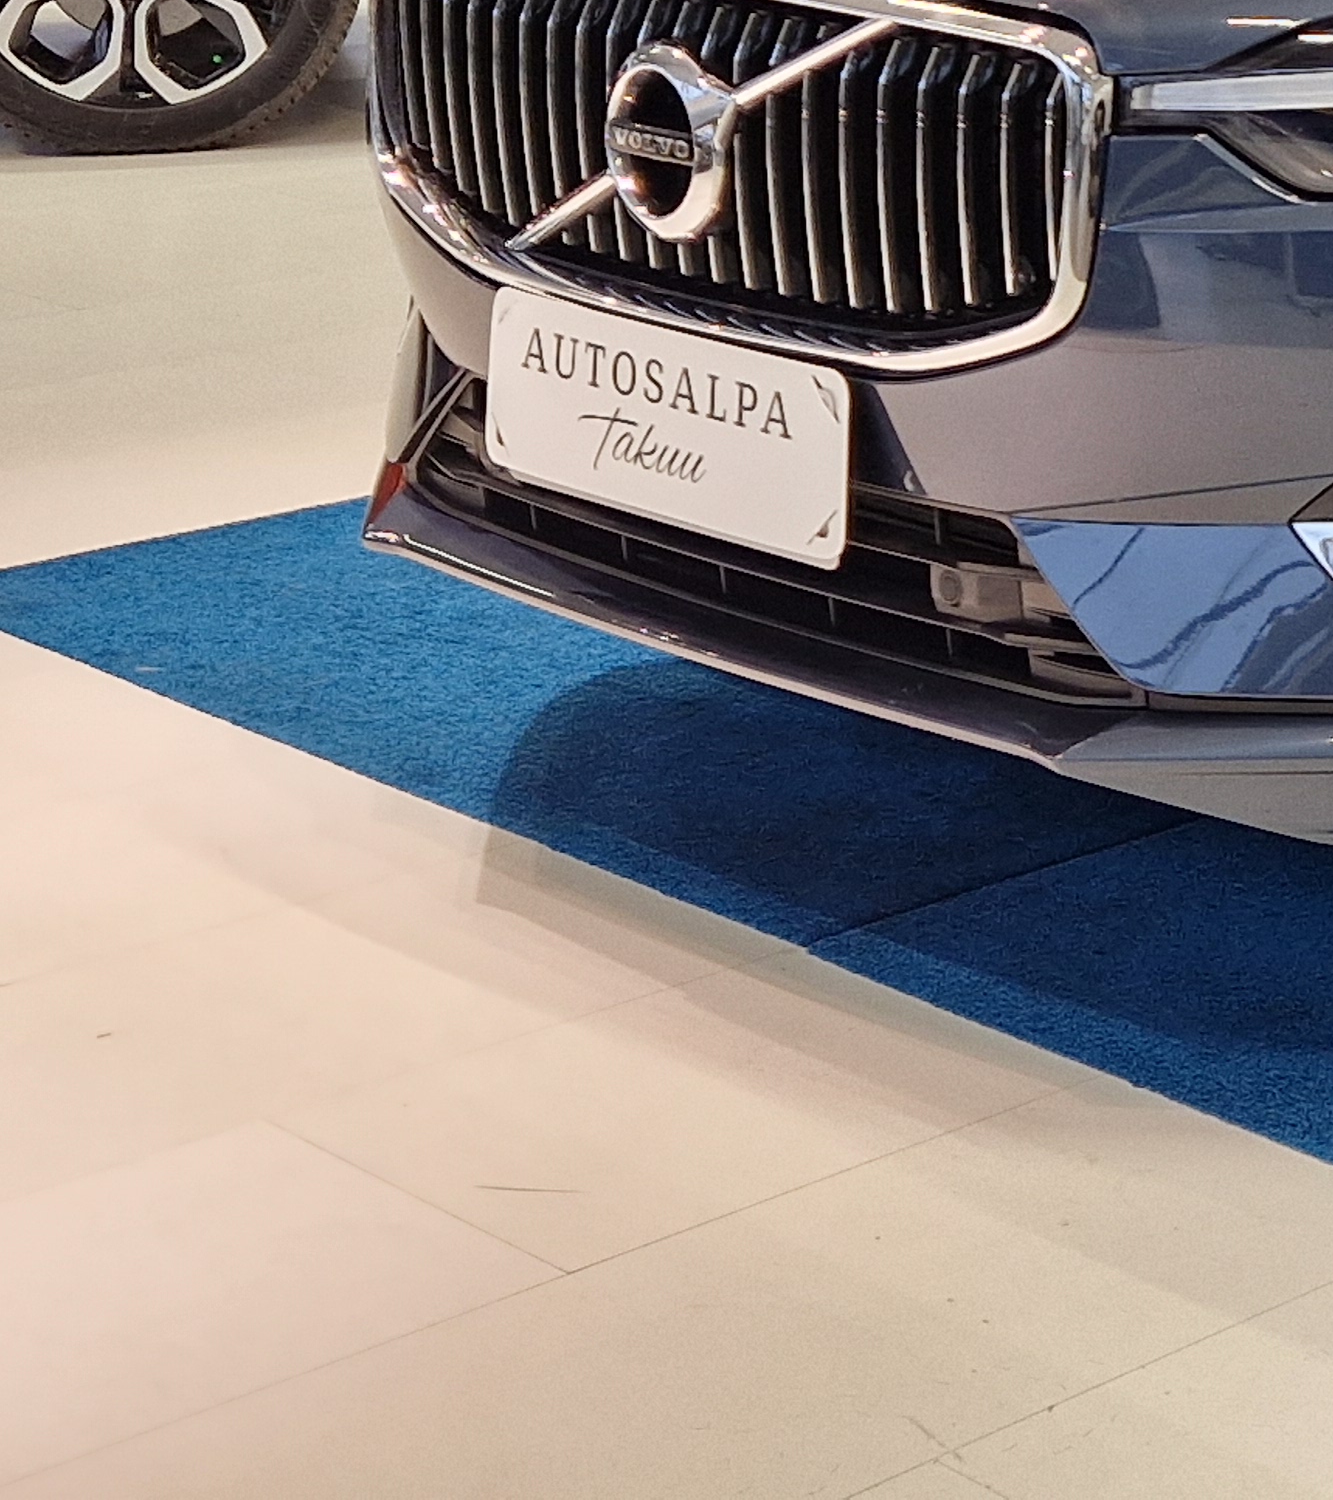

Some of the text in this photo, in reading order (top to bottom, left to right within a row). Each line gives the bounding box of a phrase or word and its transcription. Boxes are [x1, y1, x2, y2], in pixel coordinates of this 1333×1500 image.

[611, 125, 690, 159] VOLVO
[521, 327, 793, 440] AUTOSALPA
[577, 407, 707, 484] Takuu
